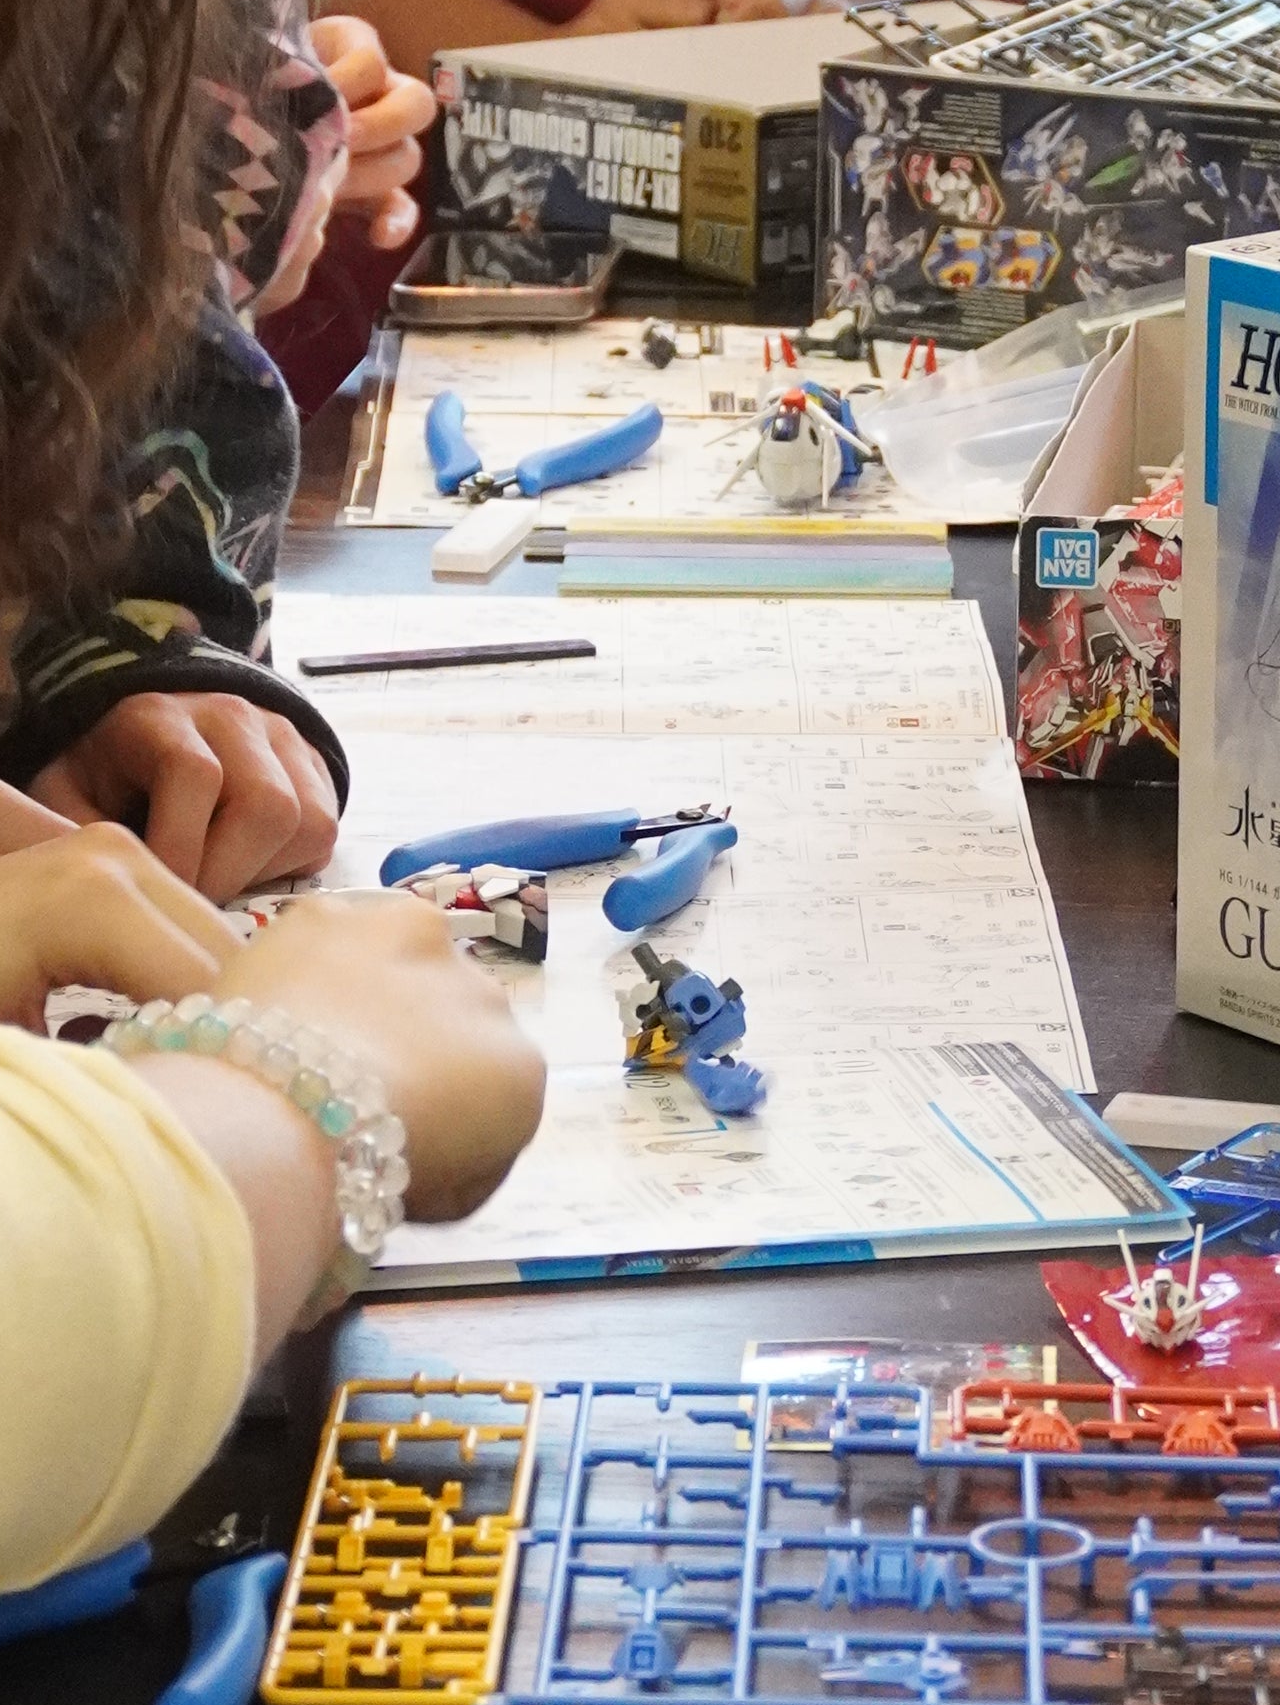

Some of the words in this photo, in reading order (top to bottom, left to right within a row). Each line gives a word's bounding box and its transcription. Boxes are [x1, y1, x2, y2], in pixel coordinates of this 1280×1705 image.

[460, 97, 507, 143] TYPE
[508, 107, 589, 158] GROUND
[1224, 394, 1238, 409] THE
[1053, 538, 1091, 559] DAI
[1043, 558, 1091, 579] BAN
[1219, 868, 1233, 885] HG
[1238, 874, 1268, 896] 1/144
